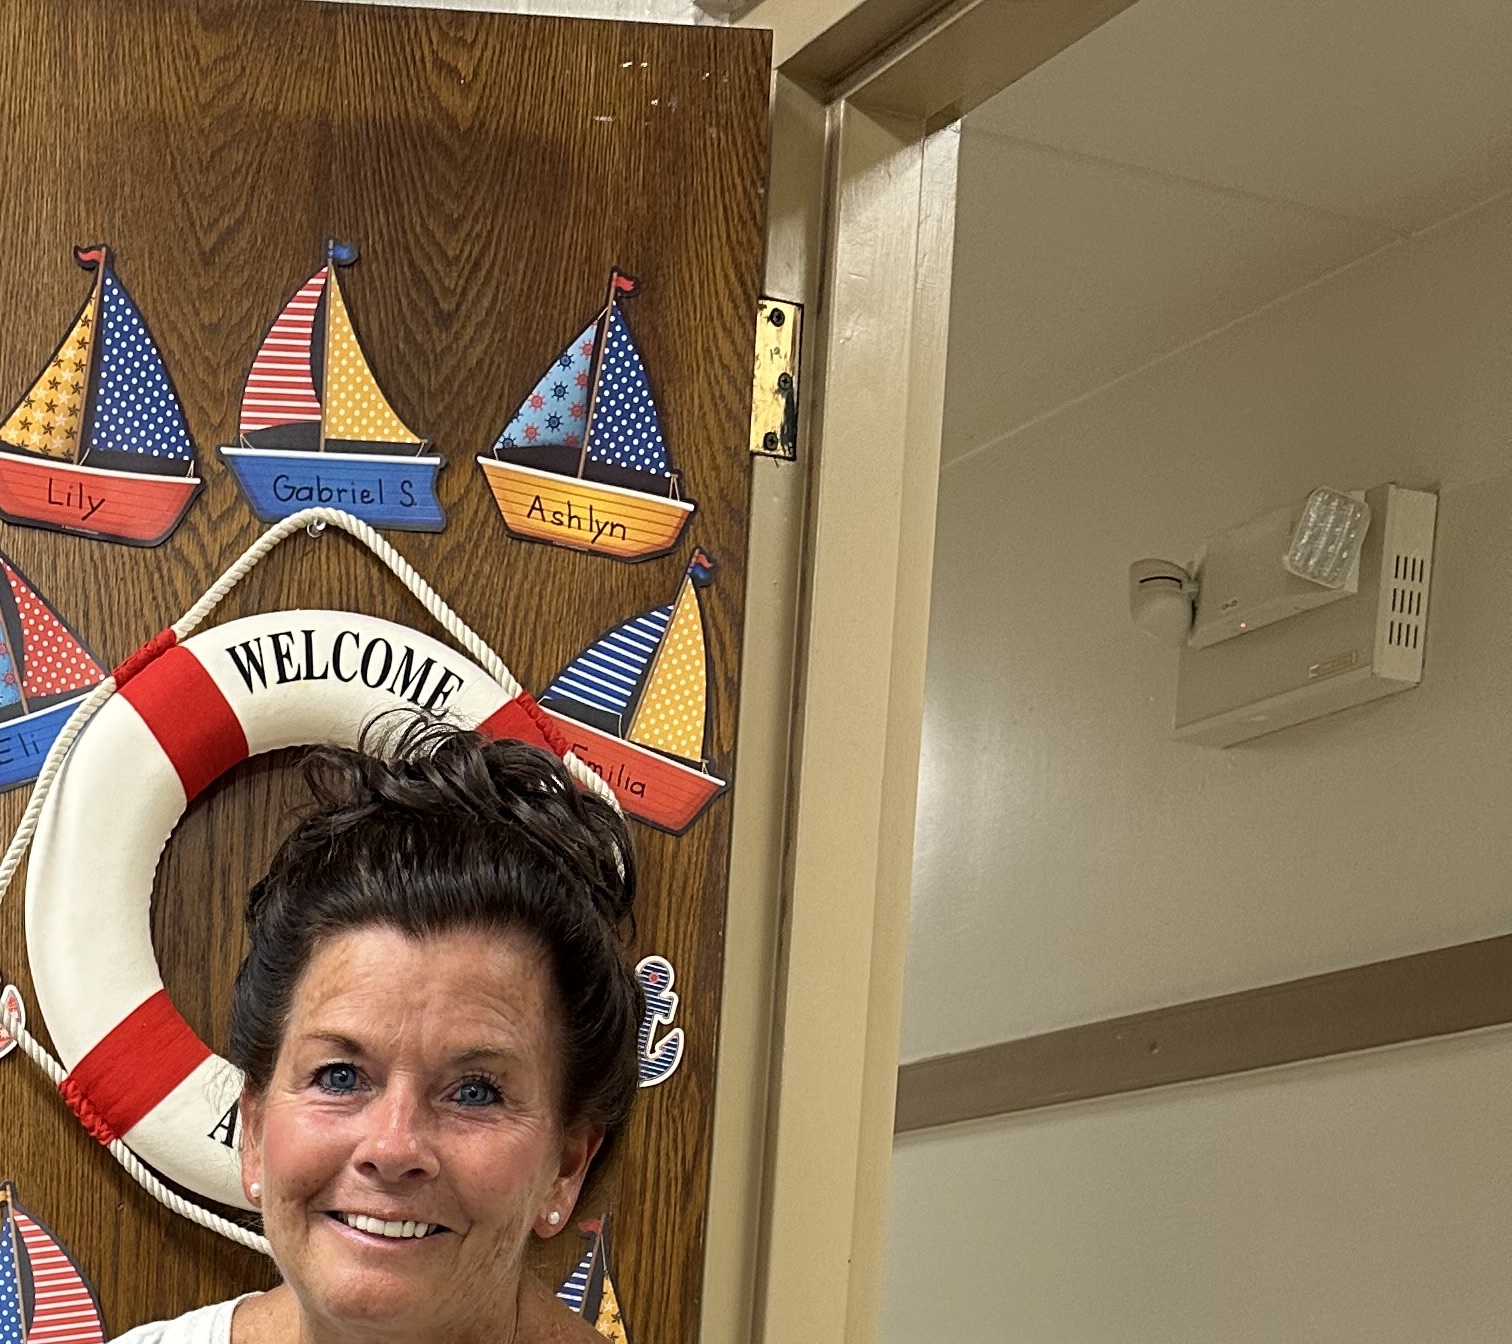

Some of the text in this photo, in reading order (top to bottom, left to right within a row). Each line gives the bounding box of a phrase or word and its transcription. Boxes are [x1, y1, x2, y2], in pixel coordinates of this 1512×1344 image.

[47, 477, 106, 521] Lily
[273, 474, 384, 505] Gabriel
[527, 496, 628, 543] Ashlyn
[225, 630, 464, 717] WELCOME
